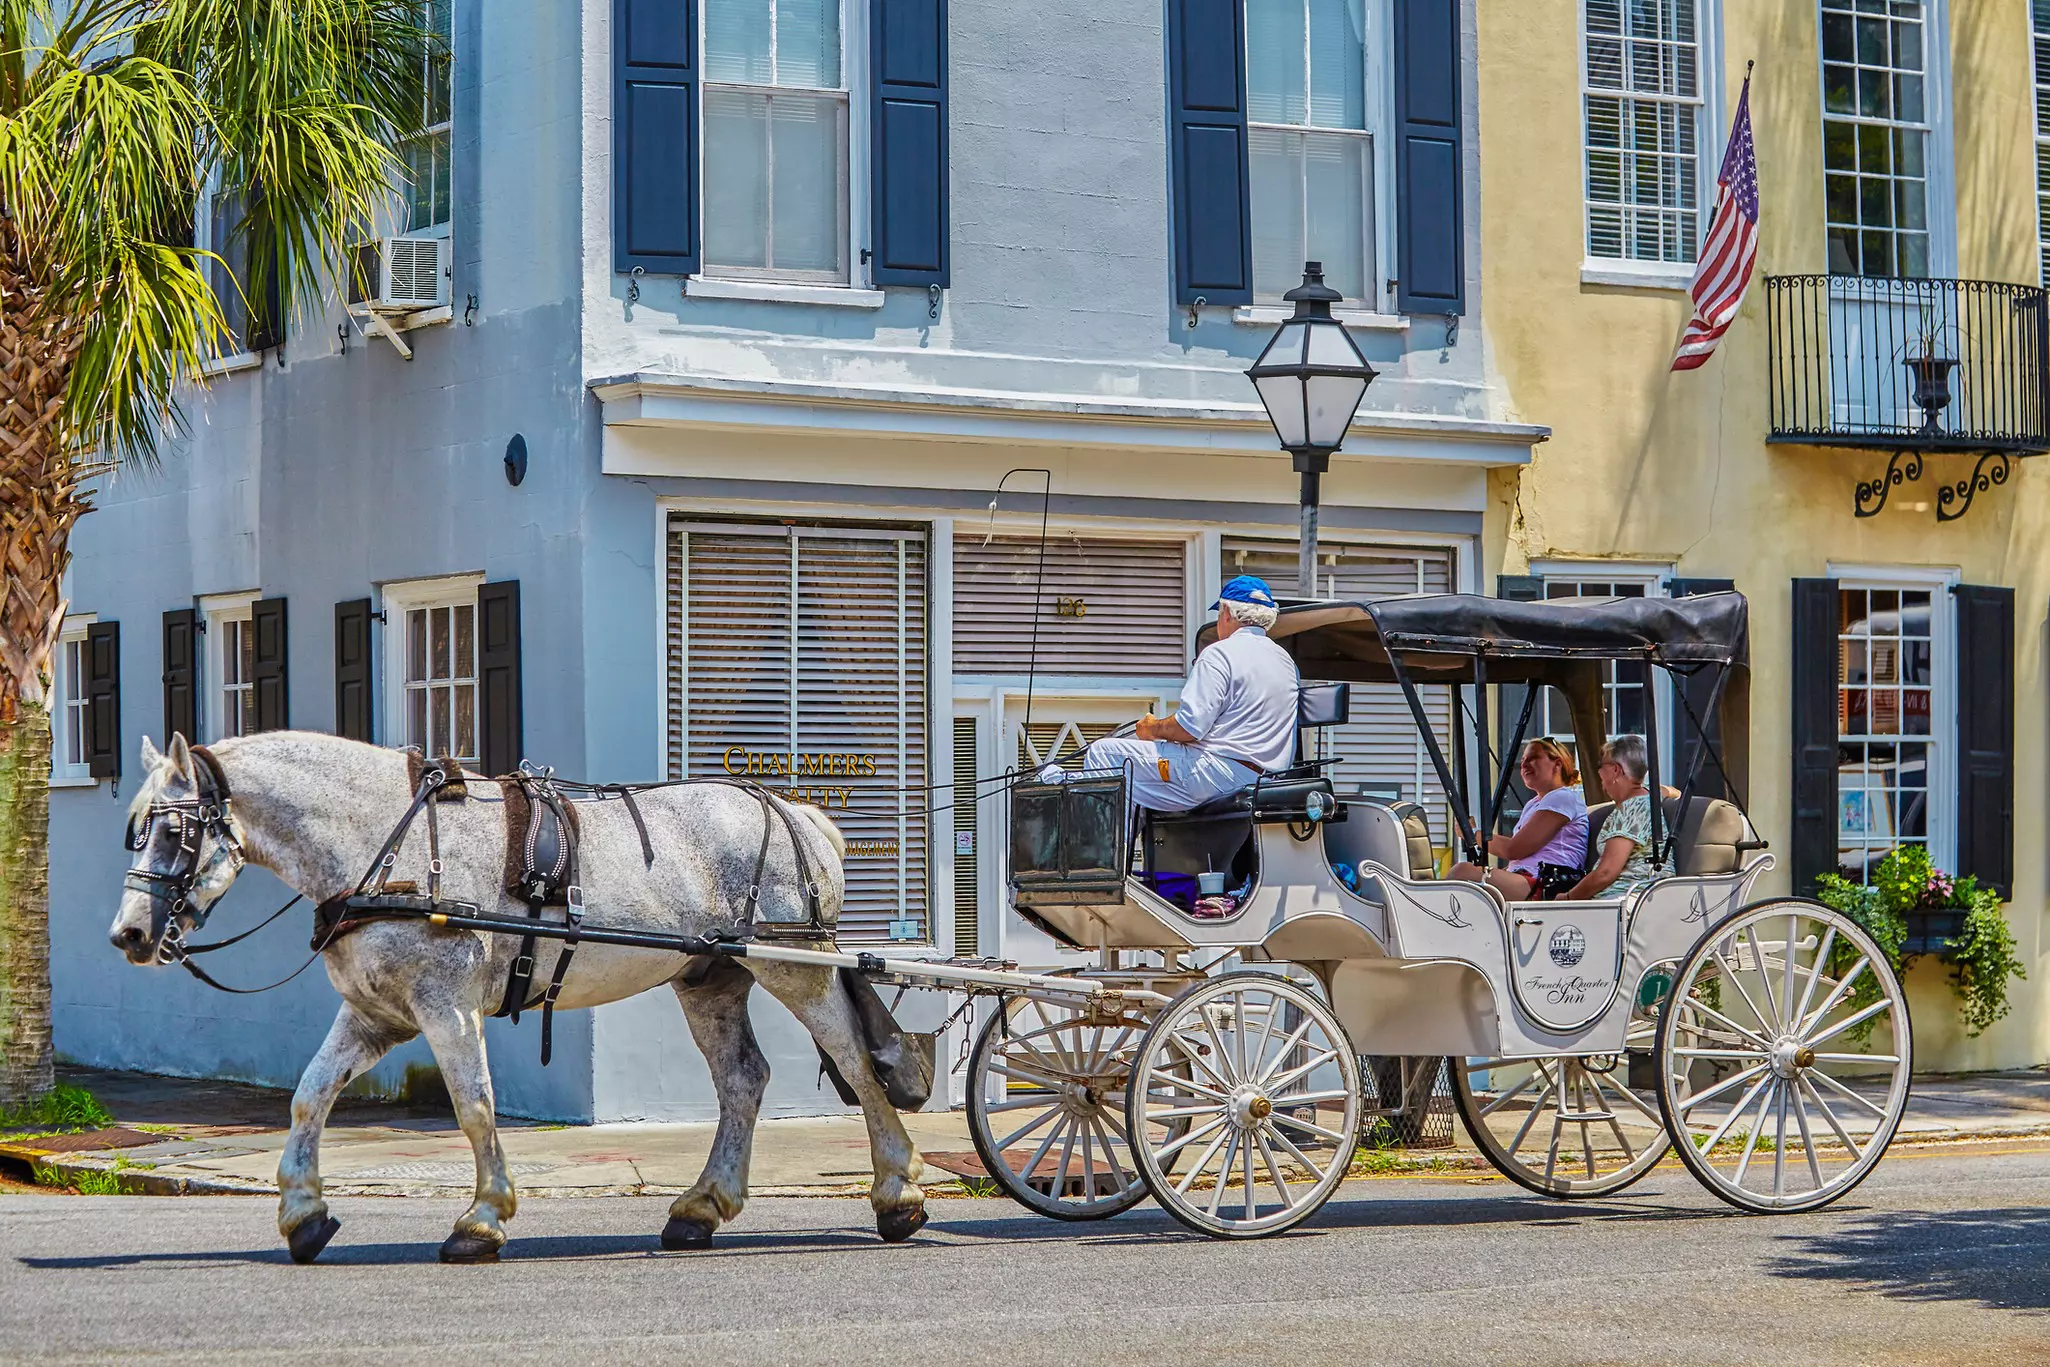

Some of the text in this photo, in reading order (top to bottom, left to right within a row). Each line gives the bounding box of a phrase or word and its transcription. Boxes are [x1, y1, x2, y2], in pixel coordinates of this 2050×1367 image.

[723, 746, 877, 776] CHALMERS
[1524, 975, 1610, 992] French Quarter
[1546, 983, 1586, 1005] Inn
